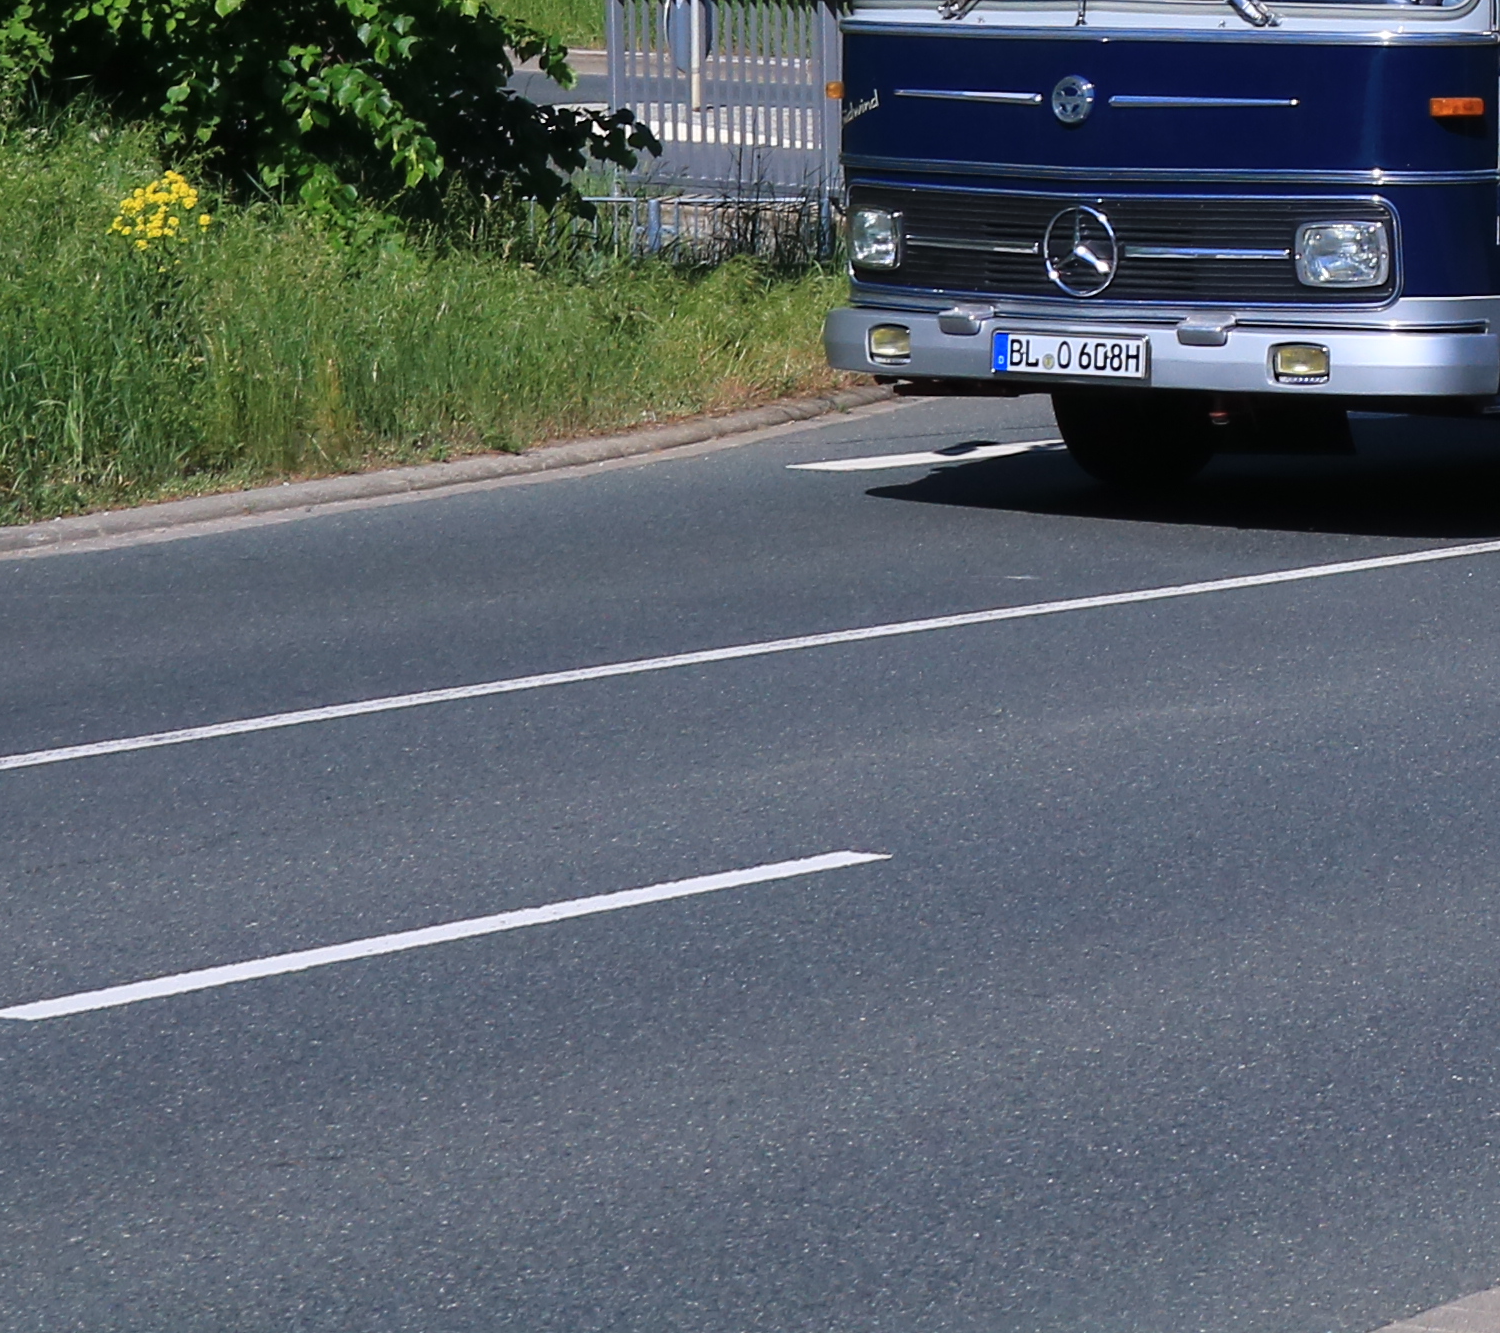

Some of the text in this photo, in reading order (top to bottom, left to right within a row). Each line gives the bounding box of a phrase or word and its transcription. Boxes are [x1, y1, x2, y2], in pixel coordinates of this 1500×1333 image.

[1010, 339, 1039, 367] BL
[1057, 341, 1072, 369] O
[1078, 342, 1140, 373] 608H
